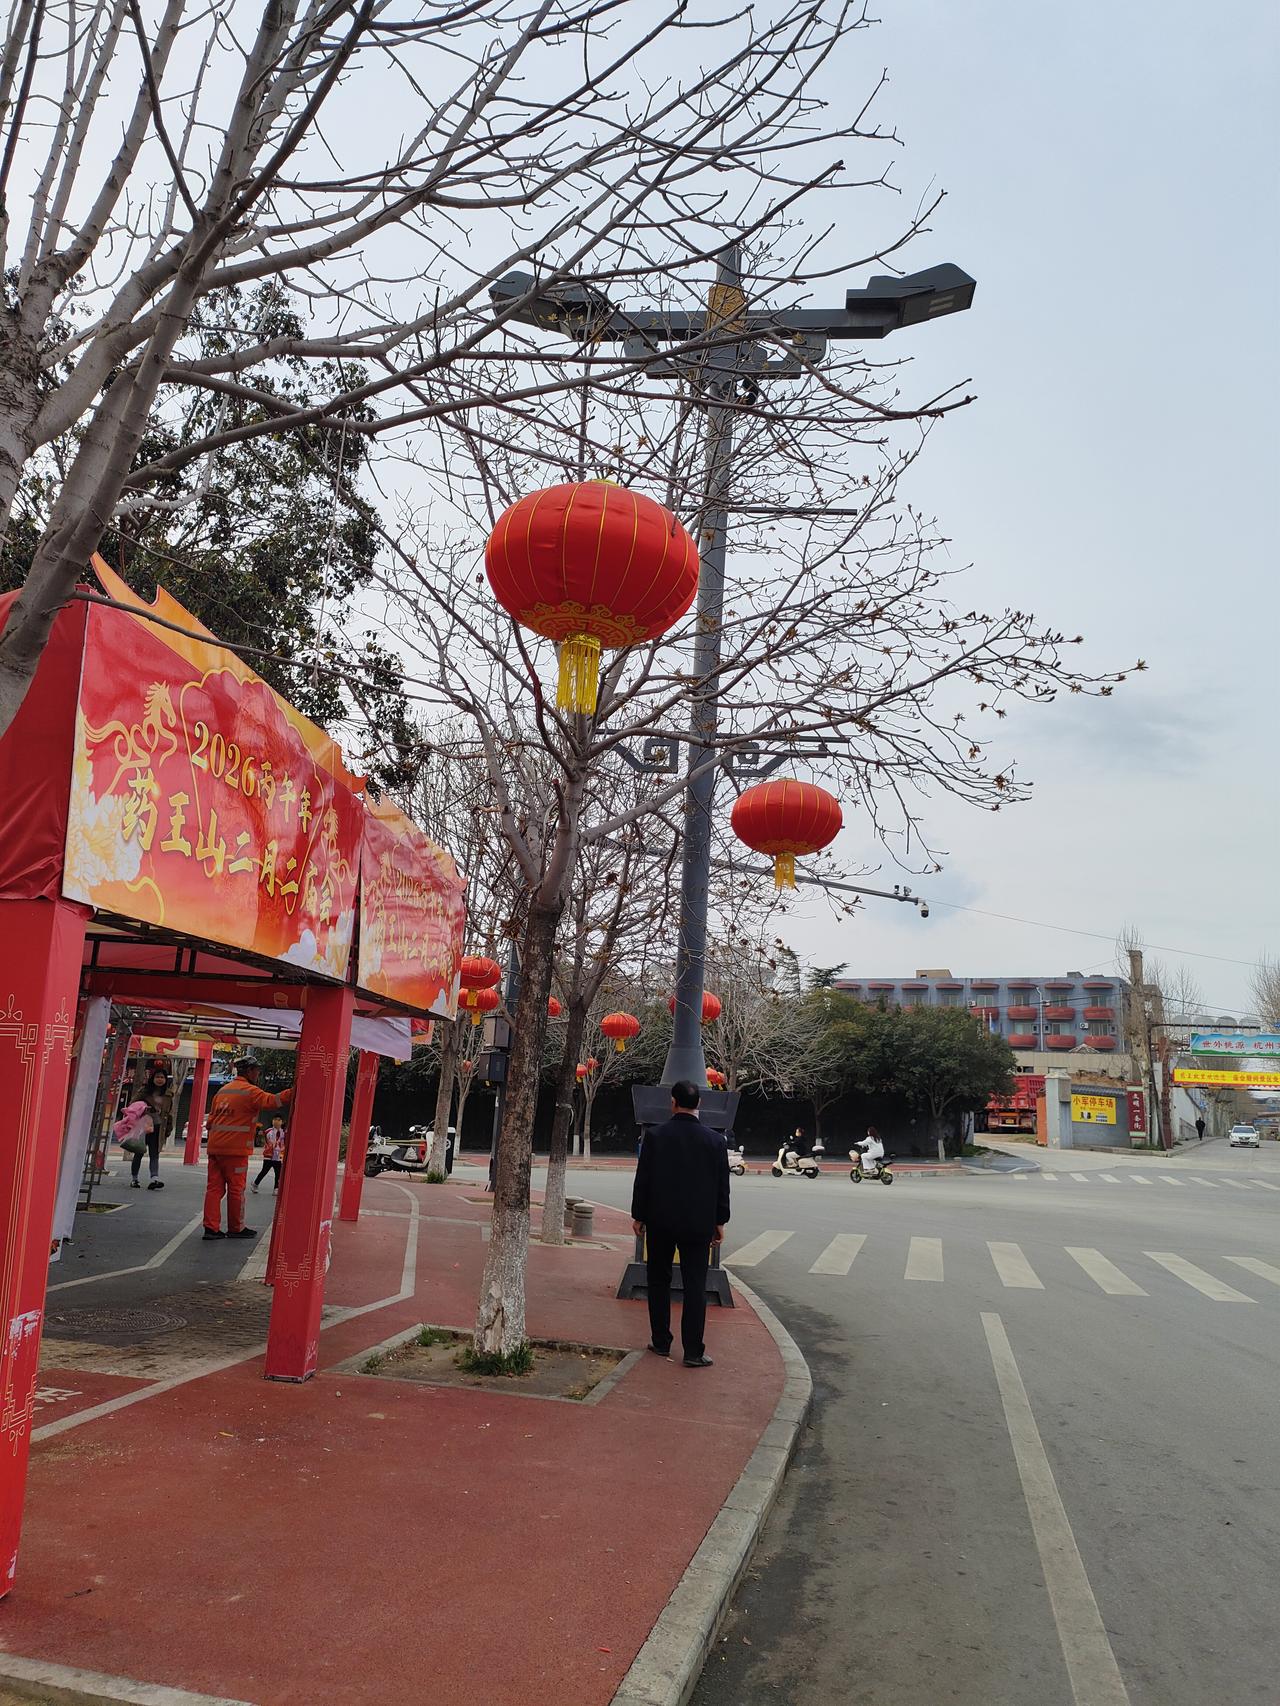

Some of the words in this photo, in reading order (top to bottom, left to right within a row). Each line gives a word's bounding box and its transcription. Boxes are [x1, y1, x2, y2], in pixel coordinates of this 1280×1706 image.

[191, 721, 313, 834] 2026丙午年
[121, 768, 333, 926] 药王山二月二庙会
[1202, 1040, 1245, 1050] 世外桃源
[1073, 1096, 1114, 1109] 小军停车场
